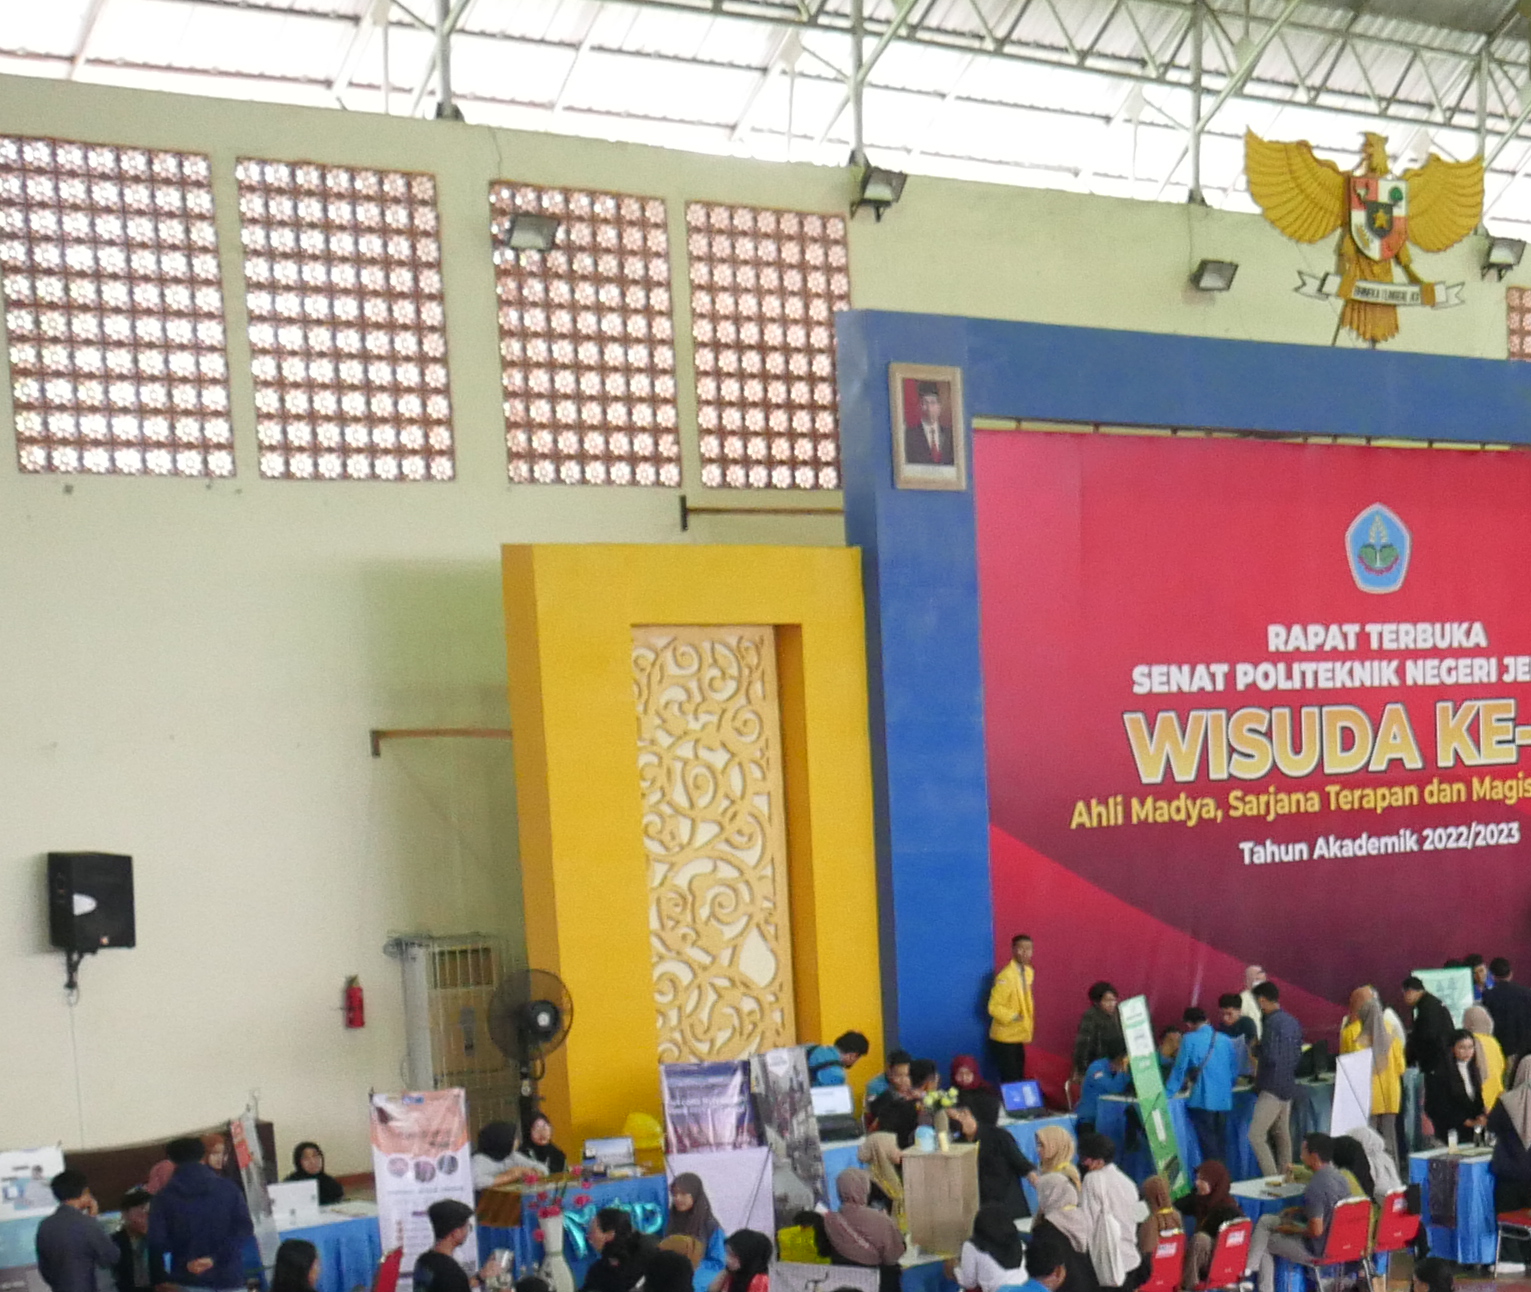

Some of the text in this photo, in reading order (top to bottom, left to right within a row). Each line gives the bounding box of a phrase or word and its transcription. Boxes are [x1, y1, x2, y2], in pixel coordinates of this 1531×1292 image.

[1267, 621, 1488, 653] RAPAT TERBUKA
[1131, 663, 1229, 694] SENAT
[1235, 658, 1400, 692] POLITEKNIK
[1405, 656, 1498, 686] NEGERI
[1122, 701, 1424, 785] WISUDA
[1069, 794, 1124, 830] Ahli
[1130, 791, 1224, 827] Madya,
[1228, 785, 1321, 822] Sarjana
[1325, 784, 1419, 814] Terapan
[1424, 777, 1466, 805] dan
[1238, 821, 1521, 866] Tahun Akademik 2022/2023
